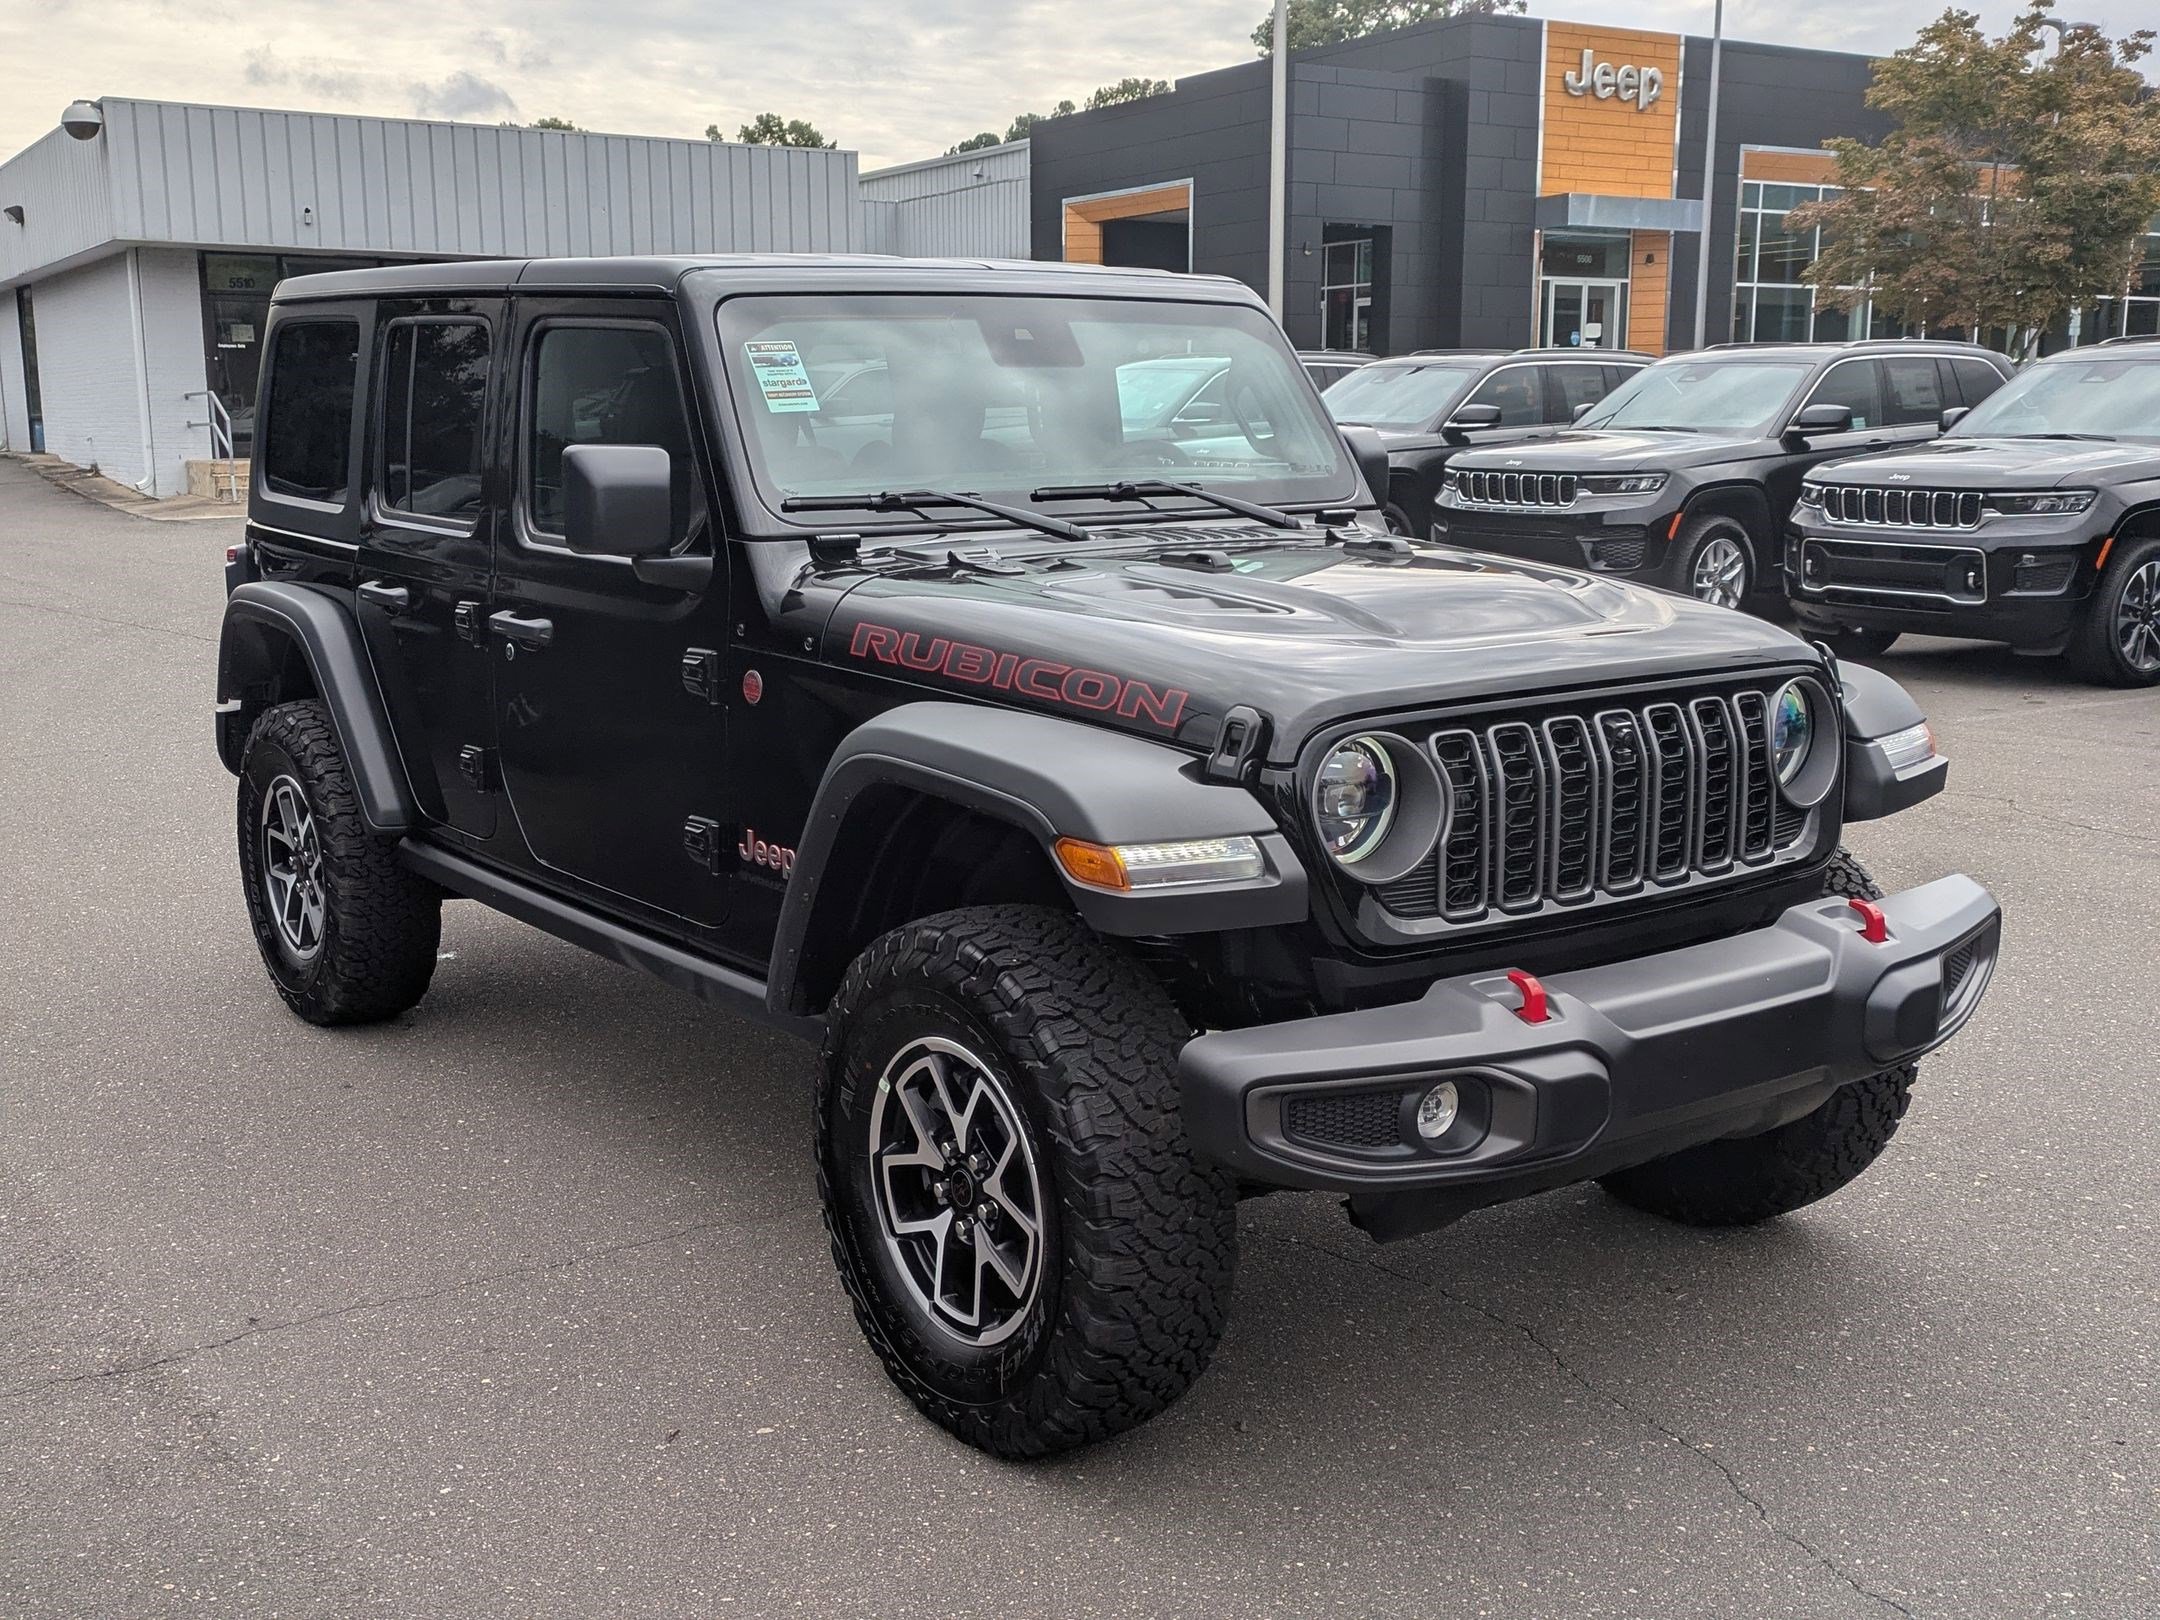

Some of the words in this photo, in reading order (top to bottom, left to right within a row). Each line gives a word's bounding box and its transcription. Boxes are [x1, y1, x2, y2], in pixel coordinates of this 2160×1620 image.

[1564, 48, 1663, 111] Jeep
[1577, 255, 1592, 264] 5500
[229, 277, 255, 289] 5510
[1889, 473, 1910, 481] Jeep
[850, 622, 1188, 728] RUBICON
[739, 828, 795, 880] Jeep
